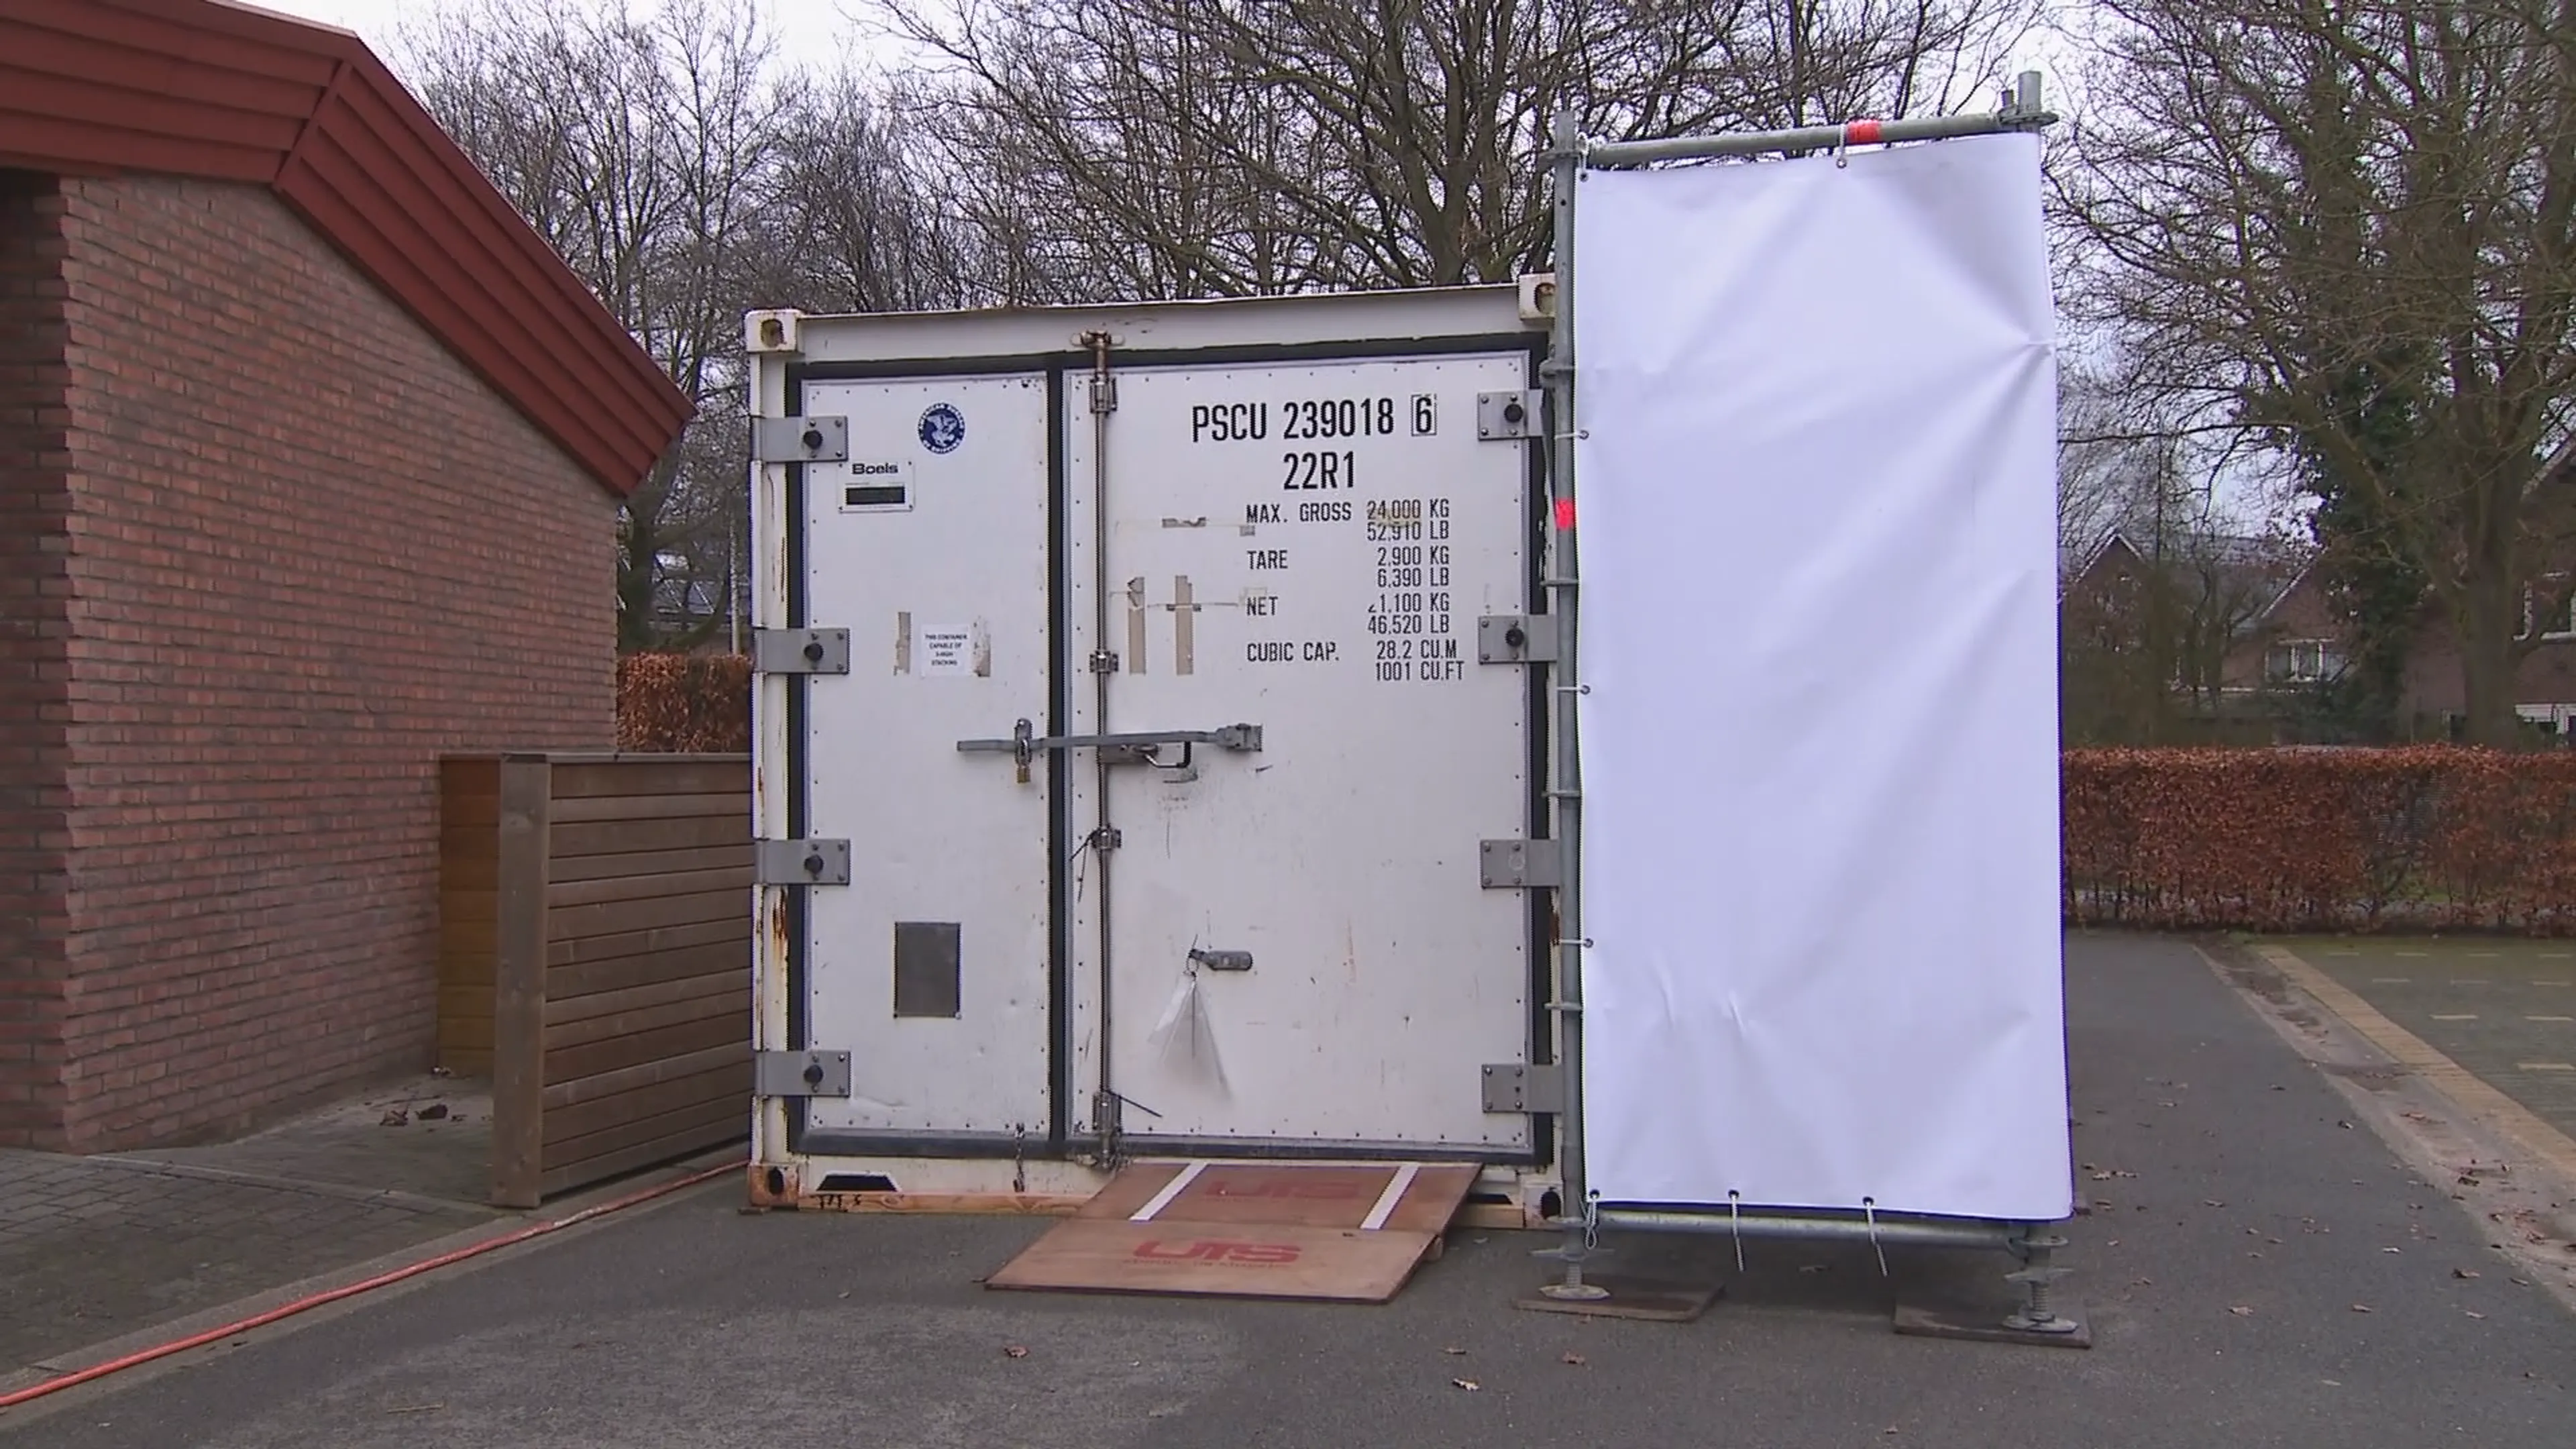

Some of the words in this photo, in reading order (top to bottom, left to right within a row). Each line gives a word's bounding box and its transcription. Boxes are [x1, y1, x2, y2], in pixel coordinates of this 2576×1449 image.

[1193, 402, 1267, 443] PSCU
[1284, 398, 1393, 439] 239018
[1414, 396, 1433, 433] 6
[852, 462, 898, 474] Boels
[1284, 451, 1353, 490] 22R1
[1246, 504, 1287, 523] MAX.
[1300, 502, 1351, 521] GROSS
[1430, 498, 1449, 518] KG
[1430, 521, 1449, 539] LB
[1247, 550, 1288, 570] TARE
[1430, 545, 1449, 565] KG
[1430, 568, 1449, 586] LB
[1247, 596, 1278, 615] NET
[1430, 592, 1449, 612] KG
[1430, 614, 1449, 633] LB
[1248, 643, 1293, 661] CUBIC
[1303, 642, 1339, 661] CAP.
[1377, 640, 1411, 659] 28.2
[1421, 639, 1456, 659] CU.M
[1376, 661, 1409, 681] 1001
[1421, 661, 1464, 680] CU.FT
